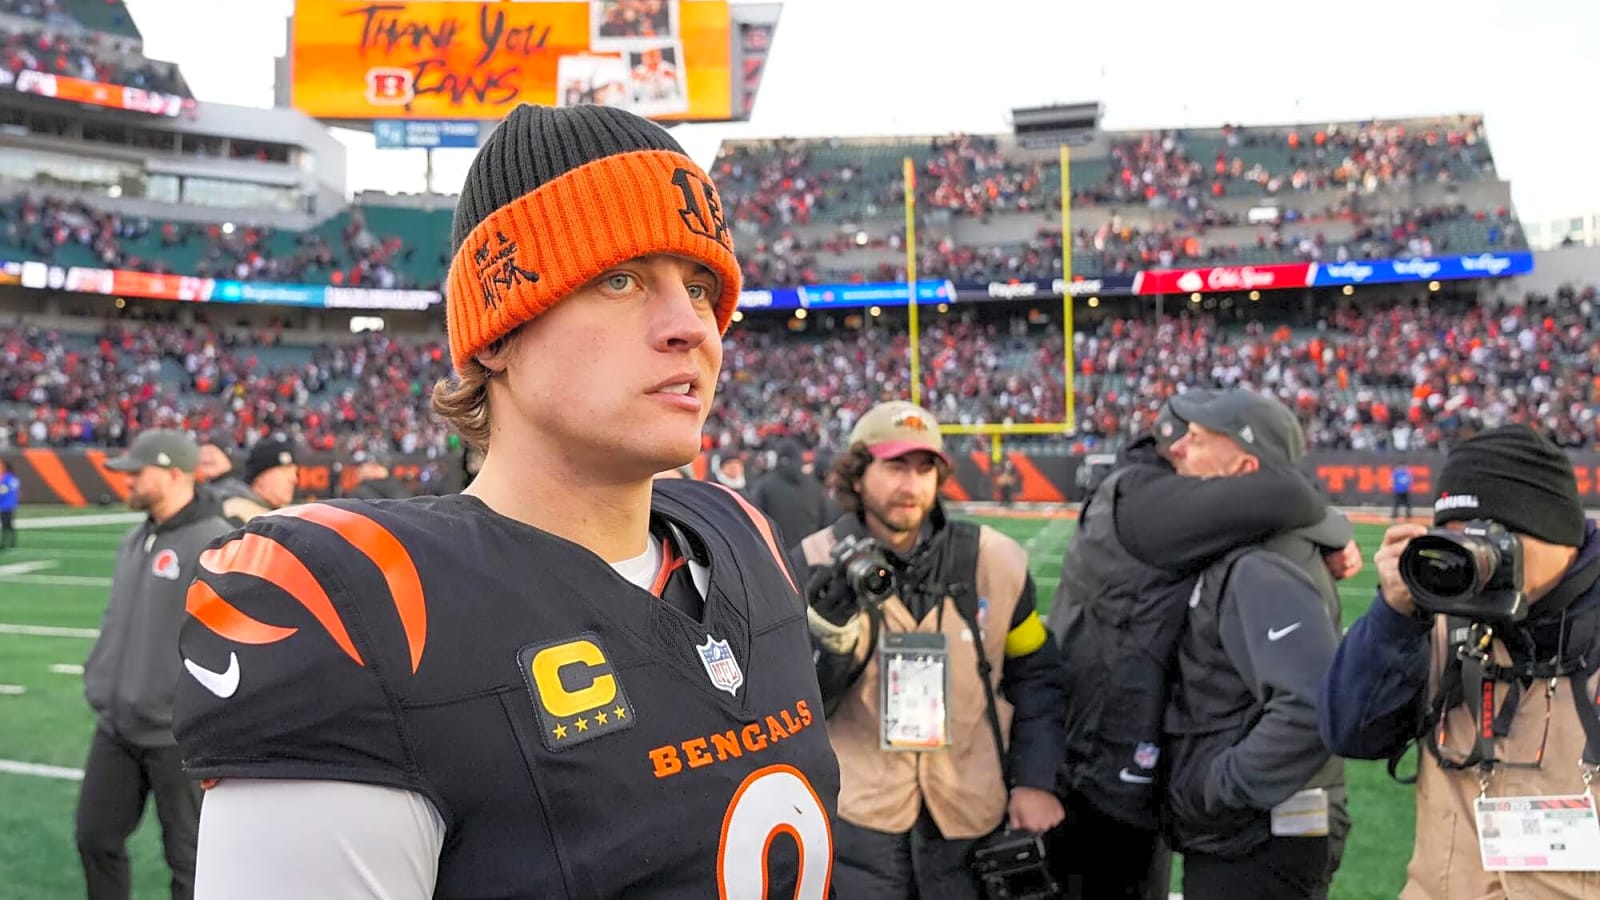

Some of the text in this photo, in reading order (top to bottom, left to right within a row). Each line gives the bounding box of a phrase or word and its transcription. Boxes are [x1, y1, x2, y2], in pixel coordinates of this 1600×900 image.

[531, 639, 618, 718] C
[711, 660, 738, 684] NFL
[648, 699, 814, 779] BENGALS
